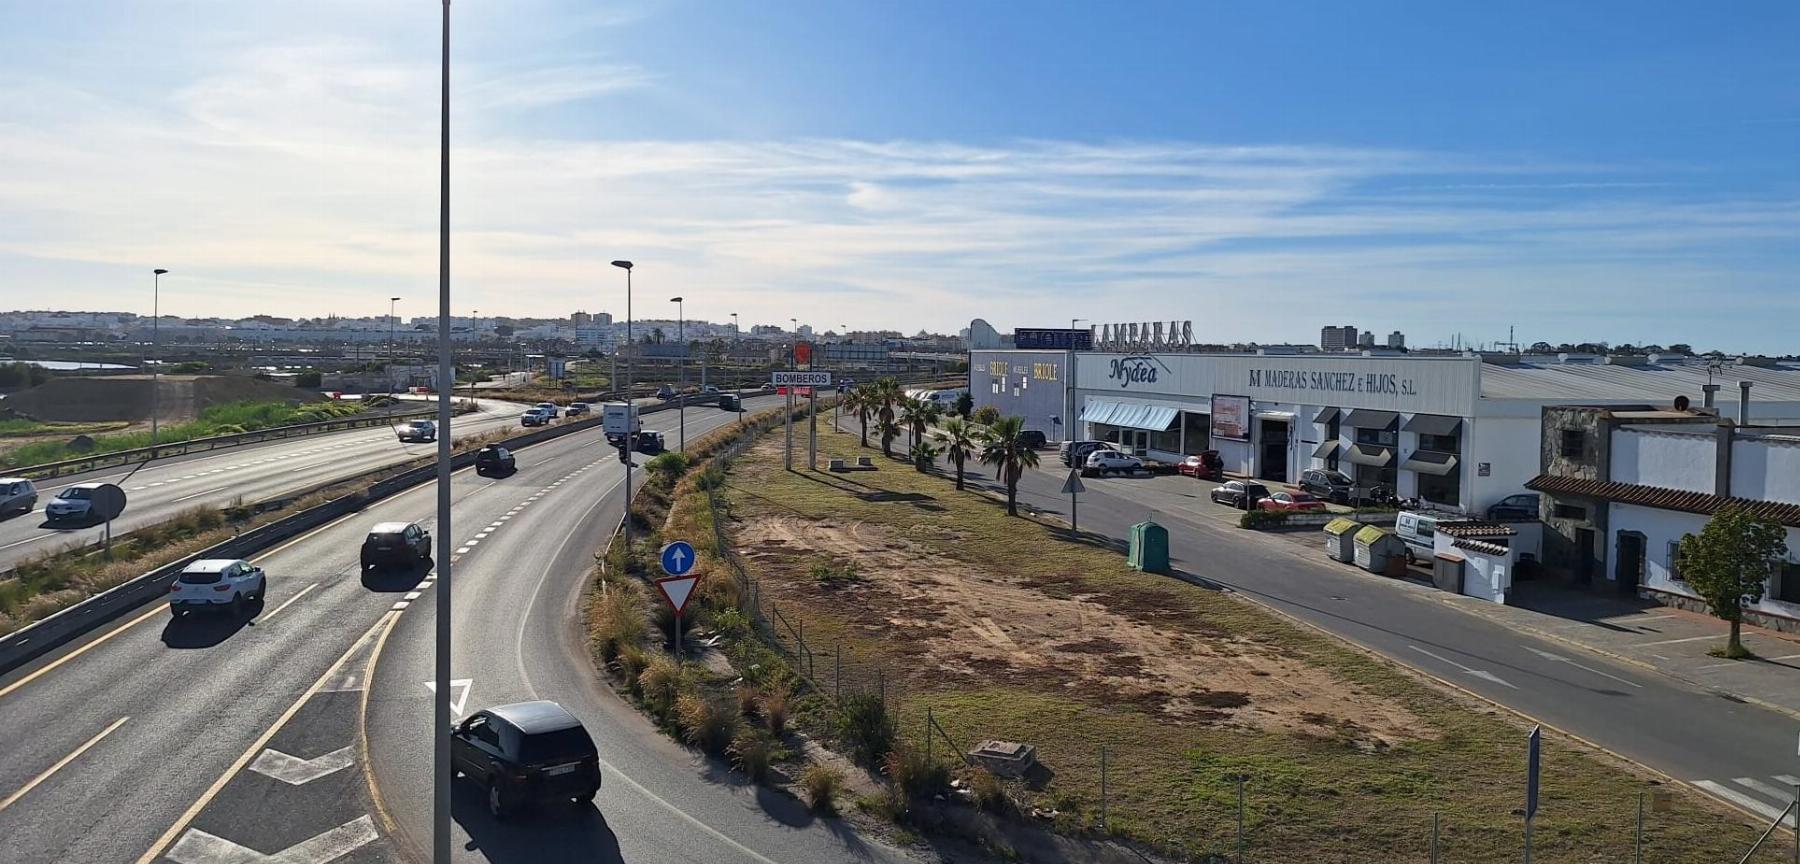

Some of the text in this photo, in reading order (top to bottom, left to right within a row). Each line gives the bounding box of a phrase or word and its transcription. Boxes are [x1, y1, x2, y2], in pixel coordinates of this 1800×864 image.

[775, 374, 827, 384] BOMBEROS
[1109, 357, 1157, 388] Nydea
[1264, 369, 1307, 389] MADERAS
[1310, 371, 1355, 392] SANCHEZ
[1358, 377, 1363, 392] E
[1366, 373, 1398, 397] HIJOS,
[1401, 379, 1417, 396] S.L.
